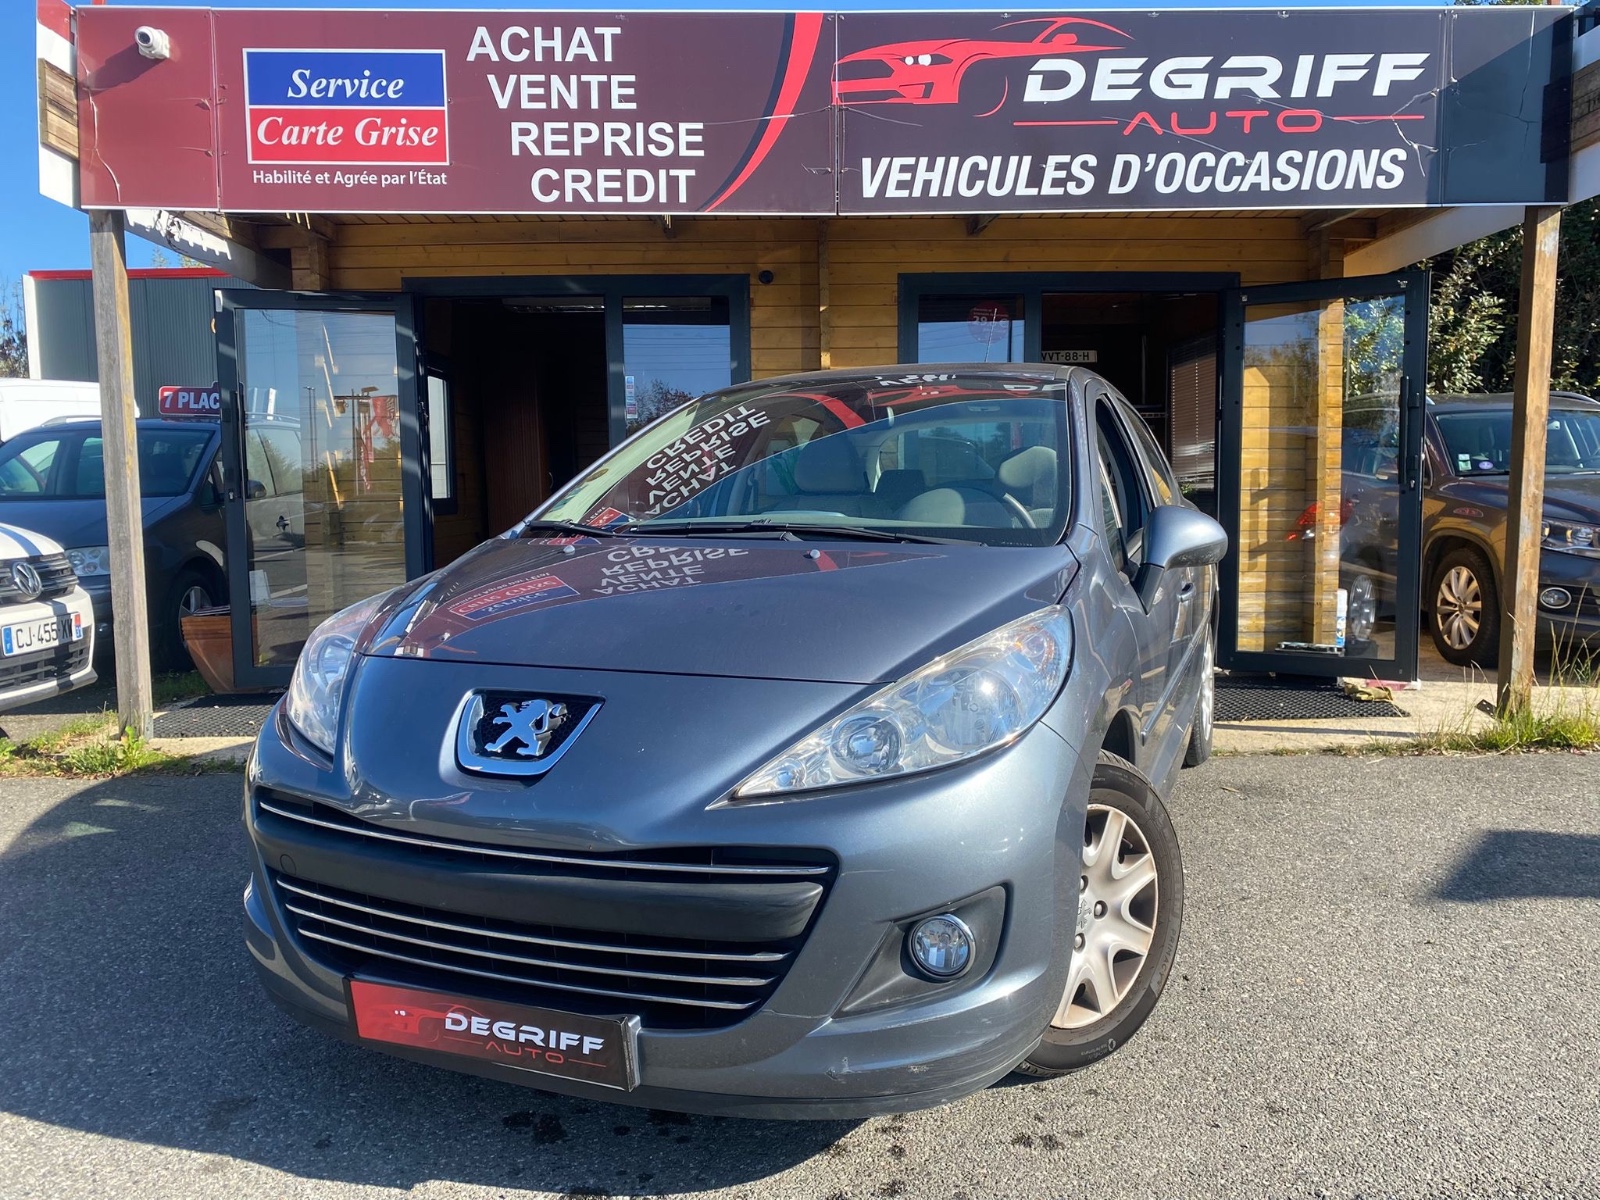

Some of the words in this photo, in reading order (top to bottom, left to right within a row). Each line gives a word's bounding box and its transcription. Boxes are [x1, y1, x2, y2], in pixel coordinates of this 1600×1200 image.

[466, 26, 621, 62] ACHAT
[287, 68, 405, 99] Service
[486, 74, 637, 110] VENTE
[1023, 53, 1431, 102] DEGRIFF
[257, 116, 344, 146] Carte
[354, 117, 439, 147] Grise
[510, 121, 705, 157] REPRISE
[1123, 109, 1323, 136] AUTO
[252, 170, 312, 184] Habilité
[315, 172, 330, 184] et
[333, 170, 378, 188] Agrée
[381, 174, 406, 188] par
[531, 168, 696, 203] CREDIT
[861, 153, 1098, 198] VEHICULES
[1107, 148, 1408, 195] D'OCCASIONS
[163, 391, 173, 408] 7
[178, 391, 220, 409] PLAC
[445, 1012, 605, 1055] DEGRIFF
[485, 1041, 564, 1064] AUTO
